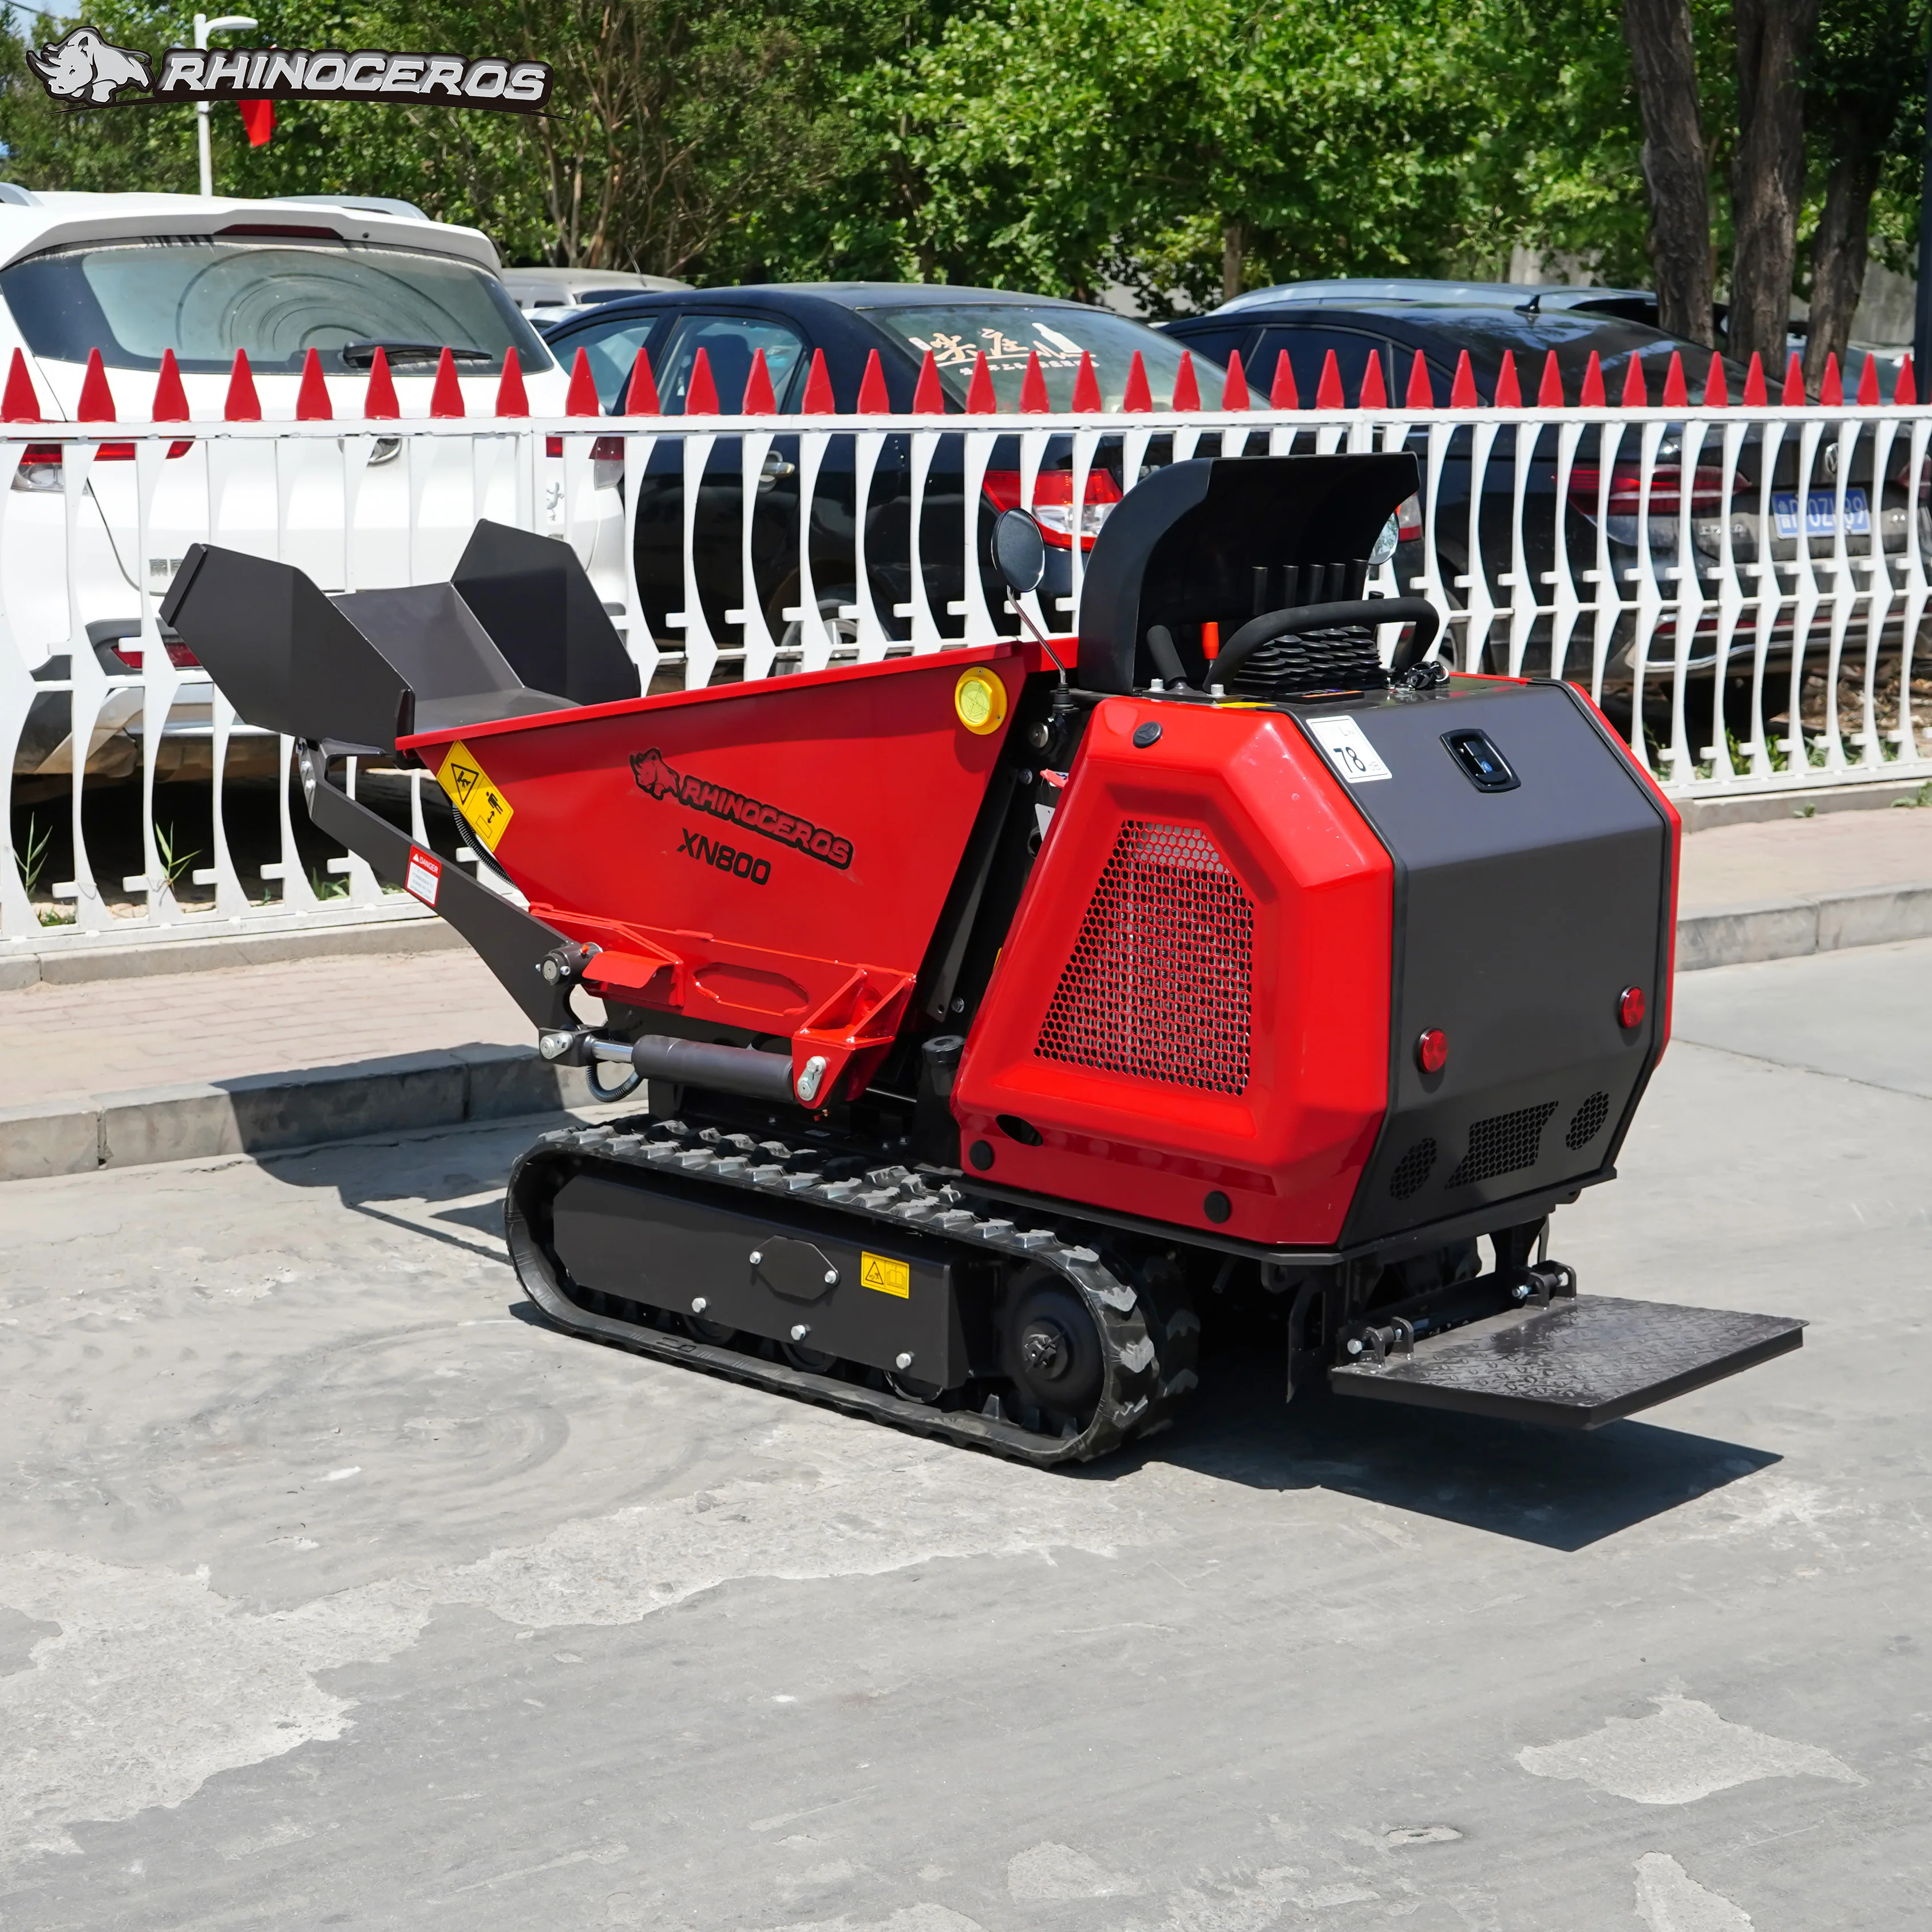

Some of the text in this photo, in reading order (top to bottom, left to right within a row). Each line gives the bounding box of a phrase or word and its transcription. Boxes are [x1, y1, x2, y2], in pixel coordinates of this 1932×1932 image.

[1333, 746, 1381, 773] 78 dB
[680, 776, 853, 869] RHINOCEROS
[419, 856, 438, 874] DANGER
[676, 827, 771, 885] XN800
